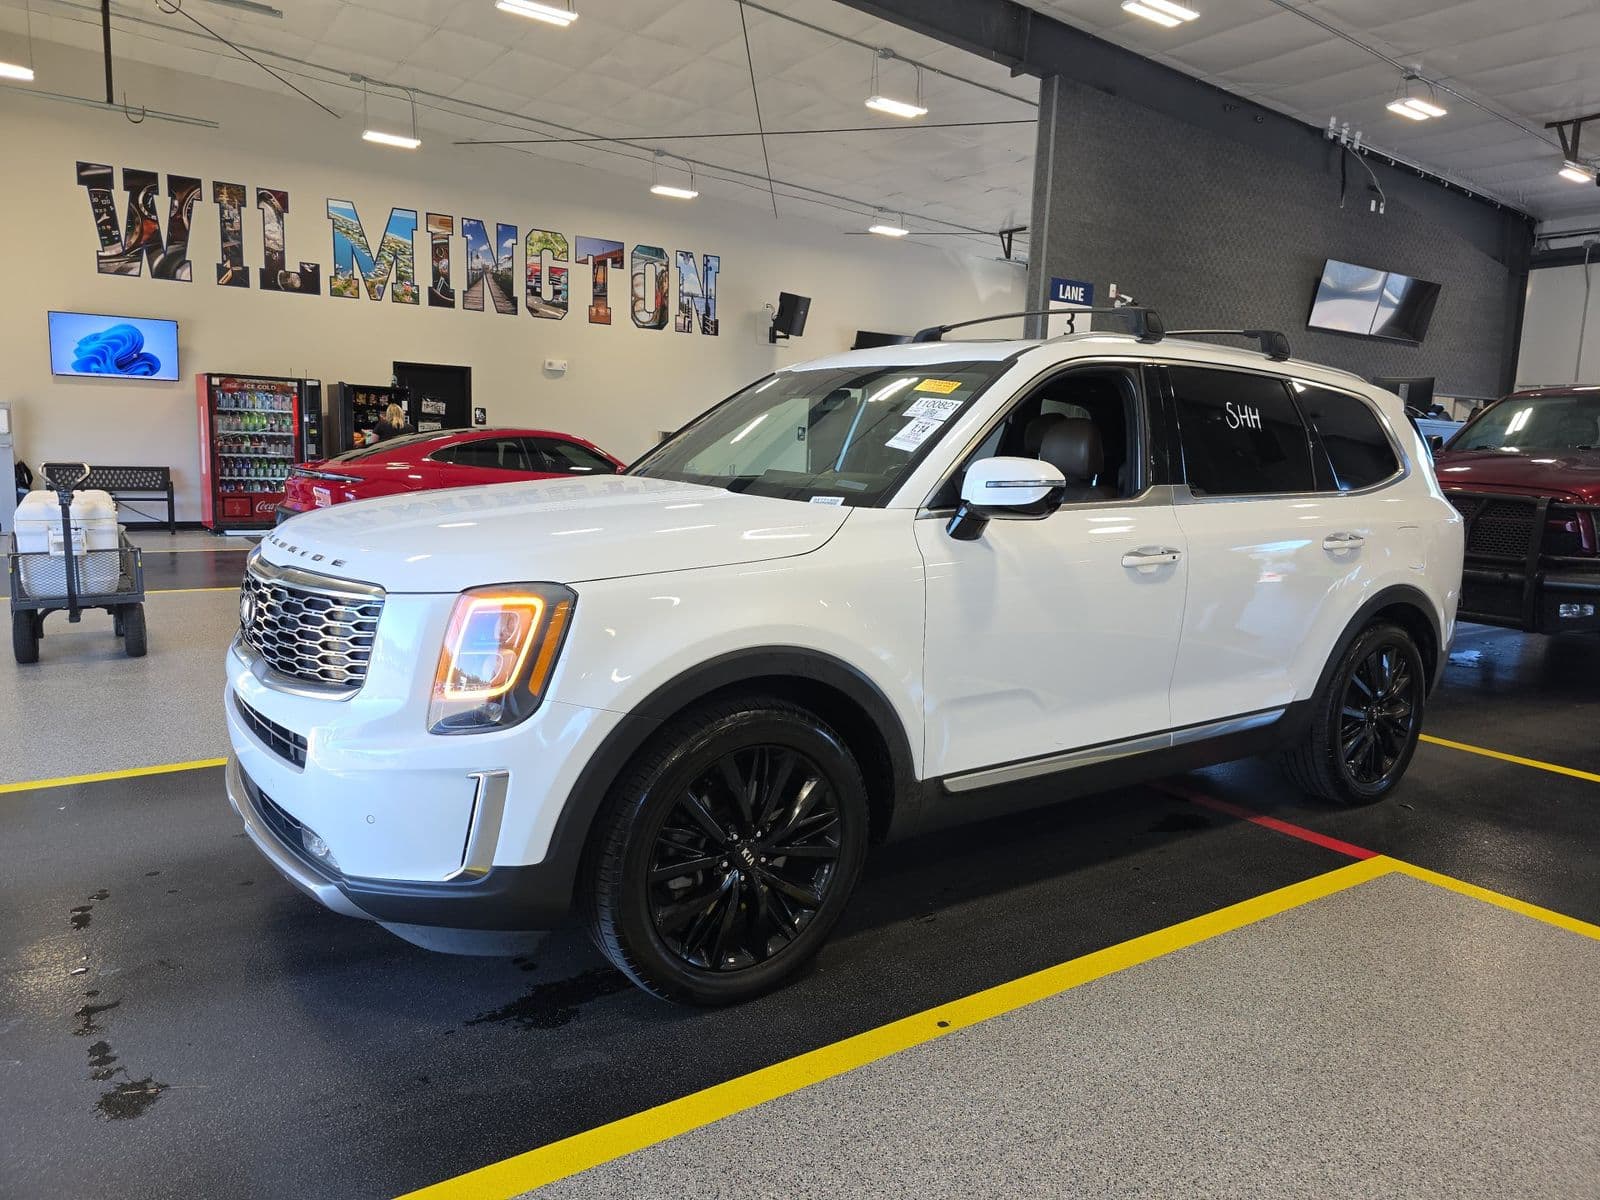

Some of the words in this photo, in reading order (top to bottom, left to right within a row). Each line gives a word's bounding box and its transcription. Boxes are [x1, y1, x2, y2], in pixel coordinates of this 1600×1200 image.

[76, 161, 720, 336] WILMINGTON
[1059, 284, 1085, 302] LANE
[1063, 312, 1075, 335] 3
[1225, 402, 1262, 432] SHH
[741, 847, 755, 866] KIA
